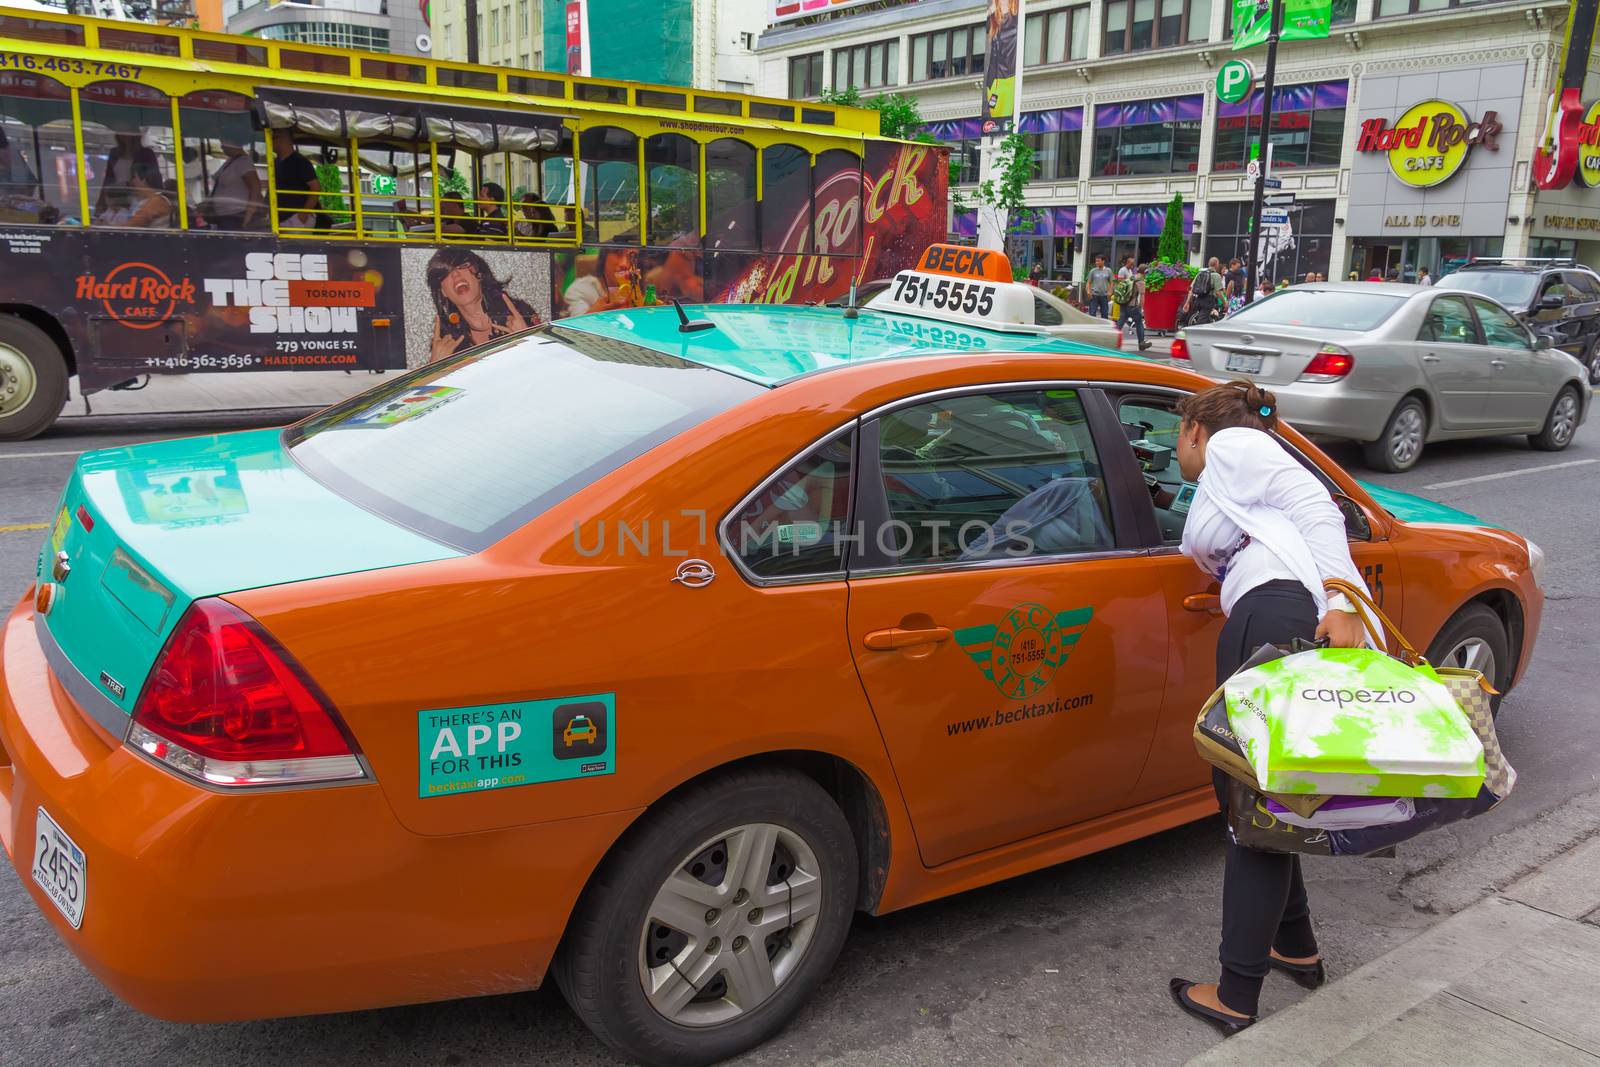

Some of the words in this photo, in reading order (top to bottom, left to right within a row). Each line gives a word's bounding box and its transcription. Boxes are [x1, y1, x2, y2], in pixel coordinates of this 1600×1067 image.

[1223, 65, 1245, 93] P
[1356, 116, 1429, 152] Hard
[1427, 111, 1503, 153] Rock
[1404, 155, 1445, 172] CAFE
[1384, 215, 1411, 228] ALL
[1413, 215, 1427, 228] IS
[1430, 214, 1461, 228] ONE
[245, 252, 328, 281] SEE
[925, 246, 990, 277] BECK
[75, 275, 138, 299] Hard
[140, 276, 196, 304] Rock
[203, 278, 290, 307] THE
[306, 289, 361, 299] TORONTO
[894, 274, 996, 317] 751-5555
[125, 306, 157, 317] CAFE
[249, 306, 358, 334] SHOW
[276, 341, 298, 353] 279
[300, 340, 340, 350] YONGE
[342, 340, 357, 350] ST.
[145, 354, 253, 369] +1-416-362-3636
[264, 355, 357, 365] HARDROCK.COM
[995, 607, 1058, 649] BECK
[1011, 649, 1046, 665] 751-5555
[1302, 686, 1416, 709] capezio
[500, 708, 523, 721] AN
[946, 693, 1094, 736] www.becktaxi.com
[429, 721, 523, 761] APP
[430, 758, 470, 776] FOR
[477, 752, 522, 770] THIS
[428, 774, 526, 793] becktaxiapp.com
[39, 833, 79, 903] 2455
[37, 869, 58, 899] TAXICAB
[57, 893, 77, 920] OWNER
